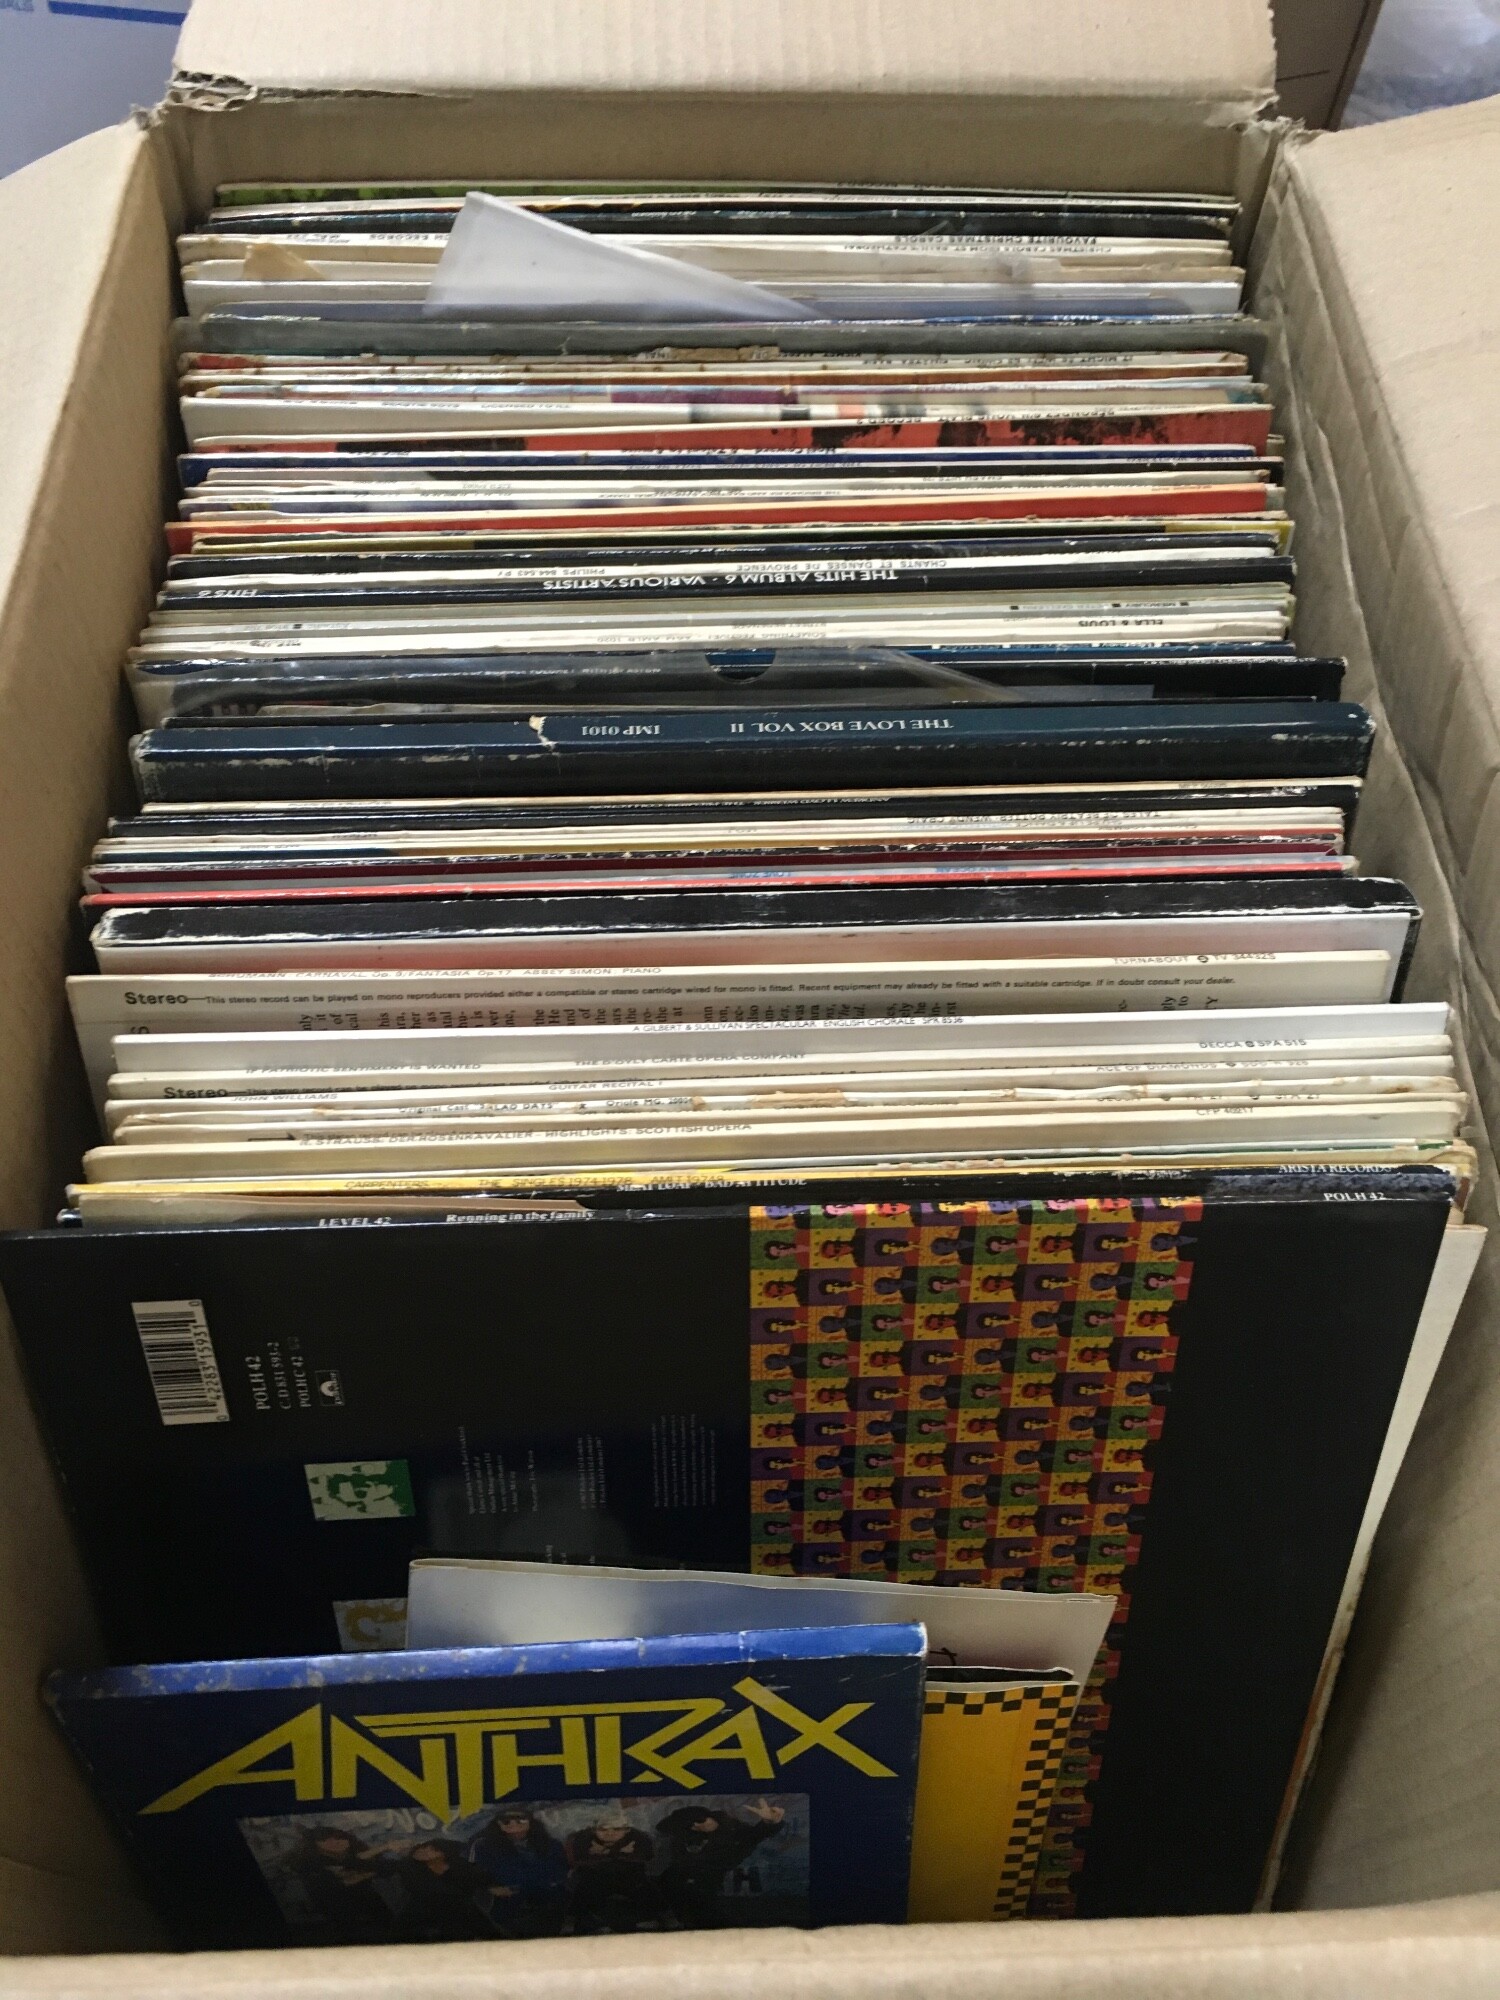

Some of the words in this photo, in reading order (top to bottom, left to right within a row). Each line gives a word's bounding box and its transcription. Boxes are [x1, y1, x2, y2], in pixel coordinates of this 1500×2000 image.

[735, 562, 799, 572] PROVENCE
[826, 560, 873, 570] DANSES
[617, 575, 707, 588] VARIOUS
[724, 573, 738, 585] 6
[740, 572, 811, 584] ALBUM
[813, 571, 856, 583] HITS
[859, 569, 899, 581] THE
[542, 578, 617, 590] ARTISTS
[1077, 620, 1116, 628] LOUIS
[580, 725, 620, 737] 0101
[622, 724, 661, 736] IMP
[729, 723, 746, 734] II
[750, 722, 796, 734] VOL
[800, 721, 845, 732] BOX
[848, 719, 906, 732] LOVE
[909, 718, 955, 731] THE
[407, 969, 471, 979] FANTASIA
[521, 968, 567, 977] ABBEY
[622, 966, 663, 975] PIANO
[124, 991, 189, 1005] Stereo
[206, 995, 226, 1004] This
[228, 996, 257, 1004] stereo
[259, 994, 290, 1004] record
[292, 995, 310, 1003] can
[312, 994, 325, 1002] be
[327, 993, 359, 1005] played
[361, 994, 375, 1002] on
[376, 993, 405, 1002] mono
[406, 991, 461, 1001] reproducers
[464, 990, 505, 1001] provided
[507, 989, 534, 999] either
[545, 987, 596, 998] compatible
[598, 988, 609, 996] or
[610, 987, 639, 996] stereo
[641, 985, 683, 997] cartridge
[685, 985, 711, 994] wired
[713, 984, 727, 994] for
[729, 985, 757, 993] mono
[758, 984, 768, 993] is
[768, 983, 796, 992] fitted.
[798, 983, 831, 992] Recent
[832, 983, 882, 994] equipment
[883, 983, 904, 993] may
[905, 981, 939, 992] already
[940, 982, 954, 990] be
[955, 980, 980, 989] fitted
[981, 979, 1003, 989] with
[1013, 979, 1050, 988] suitable
[1105, 978, 1116, 986] in
[1117, 977, 1146, 987] doubt
[1146, 977, 1182, 987] consult
[1182, 977, 1205, 987] your
[644, 1023, 682, 1032] GILBERT
[694, 1021, 745, 1031] SULLIVAN
[746, 1019, 818, 1030] SPECTACULAR
[822, 1017, 866, 1028] ENGLISH
[866, 1016, 916, 1027] CHORALE
[1199, 1040, 1242, 1050] DECCA
[1257, 1039, 1283, 1048] SPA
[163, 1086, 230, 1100] Stereo
[274, 1092, 339, 1101] WILLIAMS
[547, 1083, 597, 1091] GUITAR
[600, 1080, 655, 1090] RECITAL
[635, 1125, 704, 1136] SCOTTISH
[705, 1123, 753, 1133] OPERA
[344, 1179, 430, 1190] CARPENTERS
[476, 1178, 502, 1188] THE
[511, 1176, 566, 1188] SINGLES
[704, 1179, 733, 1190] BAD
[1278, 1163, 1327, 1174] ARISTA
[1328, 1163, 1392, 1174] RECORDS
[318, 1216, 371, 1228] LEVEL
[373, 1215, 393, 1226] 42
[509, 1211, 524, 1221] in
[525, 1210, 550, 1221] the
[550, 1209, 596, 1222] family
[1323, 1191, 1368, 1202] POLH
[1368, 1191, 1386, 1201] 42
[244, 1355, 263, 1371] 42
[248, 1372, 272, 1411] POLH
[137, 1676, 900, 1827] ANTHRAX
